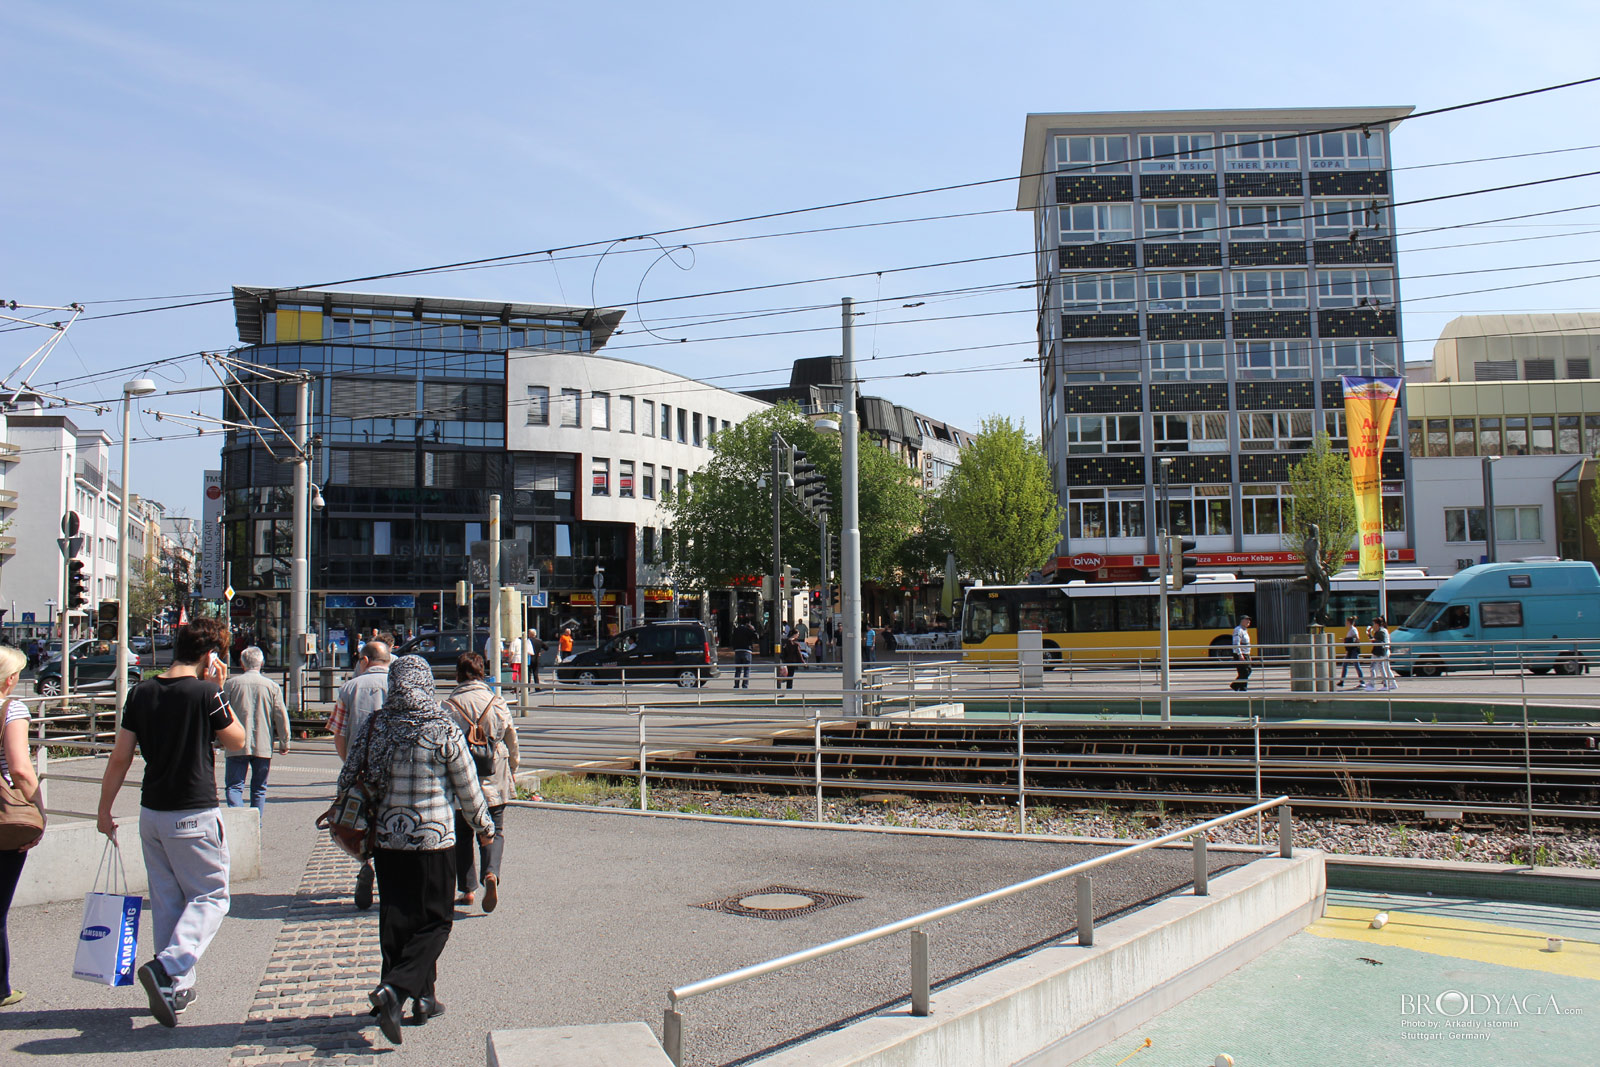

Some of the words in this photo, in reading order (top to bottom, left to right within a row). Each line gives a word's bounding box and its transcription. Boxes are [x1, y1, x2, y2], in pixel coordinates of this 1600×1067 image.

[1230, 161, 1291, 171] THERAPIE
[1312, 160, 1341, 169] GOPA
[204, 520, 213, 568] STUTTGART
[1250, 554, 1274, 563] Kebap
[204, 570, 212, 589] TMS
[175, 820, 198, 830] LIMITED
[120, 907, 137, 976] SAMSUNG
